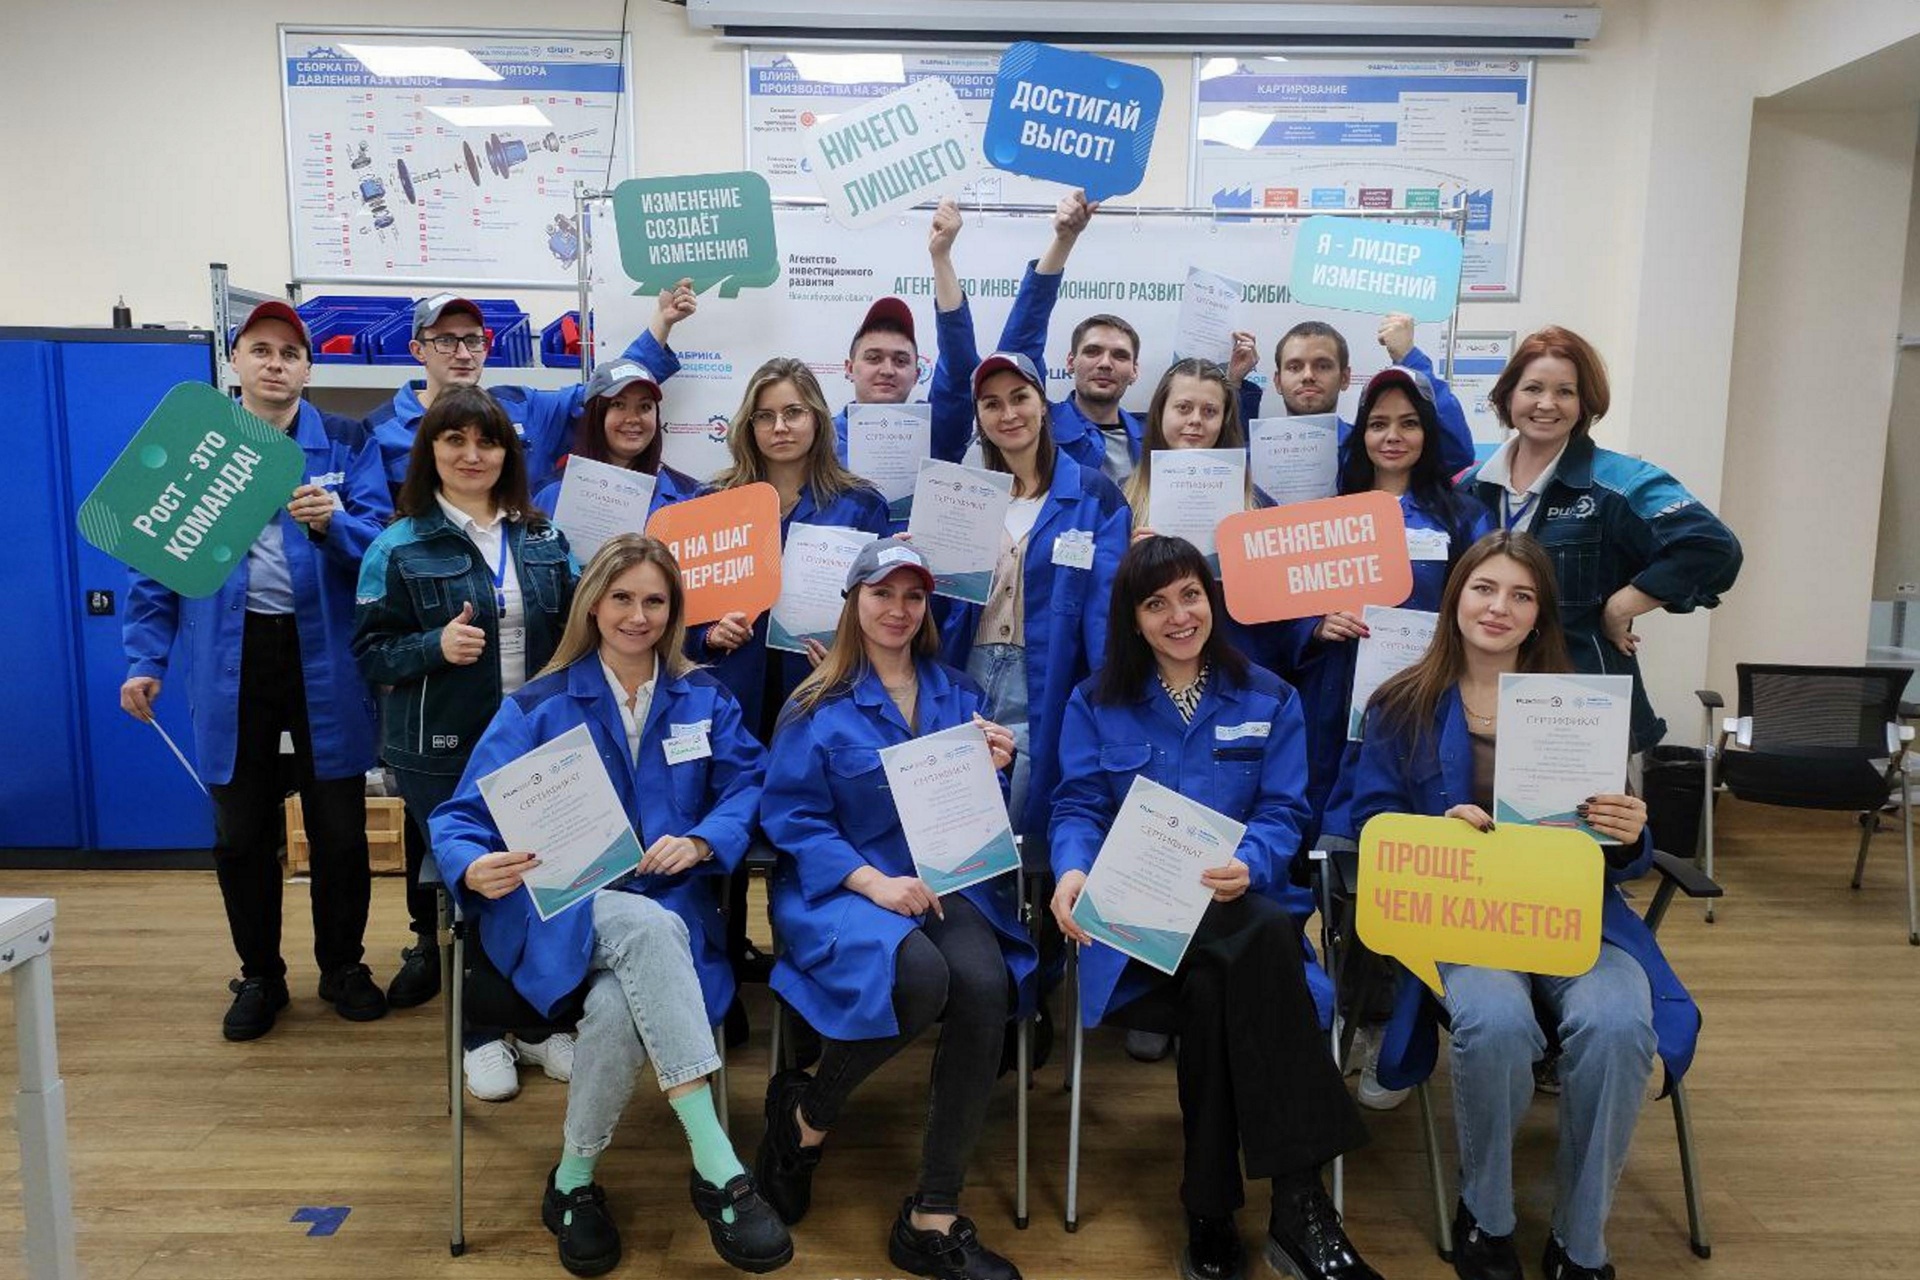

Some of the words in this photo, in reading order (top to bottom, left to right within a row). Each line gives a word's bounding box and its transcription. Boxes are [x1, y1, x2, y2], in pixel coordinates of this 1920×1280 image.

[296, 62, 342, 72] СБОРКА
[493, 65, 547, 76] УЛЯТОРА
[296, 74, 361, 85] ДАВЛЕНИЯ
[363, 75, 393, 85] ГАЗА
[759, 71, 801, 81] ВЛИЯН
[759, 83, 851, 95] ПРОИЗВОДСТВА
[852, 85, 869, 95] НА
[1257, 84, 1348, 95] КАРТИРОВАНИЕ
[1010, 81, 1141, 132] ДОСТИГАЙ
[818, 103, 919, 170] НИЧЕГО
[1020, 120, 1115, 163] ВЫСОТ!
[843, 138, 966, 217] ЛИШНЕГО
[641, 187, 742, 214] ИЗМЕНЕНИЕ
[645, 214, 720, 239] СОЗДАЁТ
[649, 238, 749, 265] ИЗМЕНЕНИЯ
[789, 253, 837, 264] Агентство
[1317, 233, 1332, 255] Я
[1348, 238, 1421, 266] ЛИДЕР
[789, 267, 873, 277] инвестиционного
[789, 277, 834, 288] развития
[1312, 264, 1437, 300] ИЗМЕНЕНИЙ
[894, 277, 976, 297] АГЕНТВО
[1129, 282, 1185, 301] РАЗВИТ
[676, 352, 722, 360] АБРИКА
[682, 363, 733, 373] ОЦЕССОВ
[190, 430, 227, 471] ЭТО
[164, 444, 262, 561] КОМАНДА!
[668, 541, 679, 562] Я
[684, 535, 708, 559] НА
[713, 523, 753, 553] ШАГ
[1243, 513, 1376, 560] МЕНЯЕМСЯ
[681, 555, 754, 589] ПЕРЕДИ!
[1288, 554, 1382, 595] ВМЕСТЕ
[1377, 840, 1483, 885] ПРОЩЕ,
[1374, 887, 1433, 925] ЧЕМ
[1441, 895, 1582, 942] КАЖЕТСЯ
